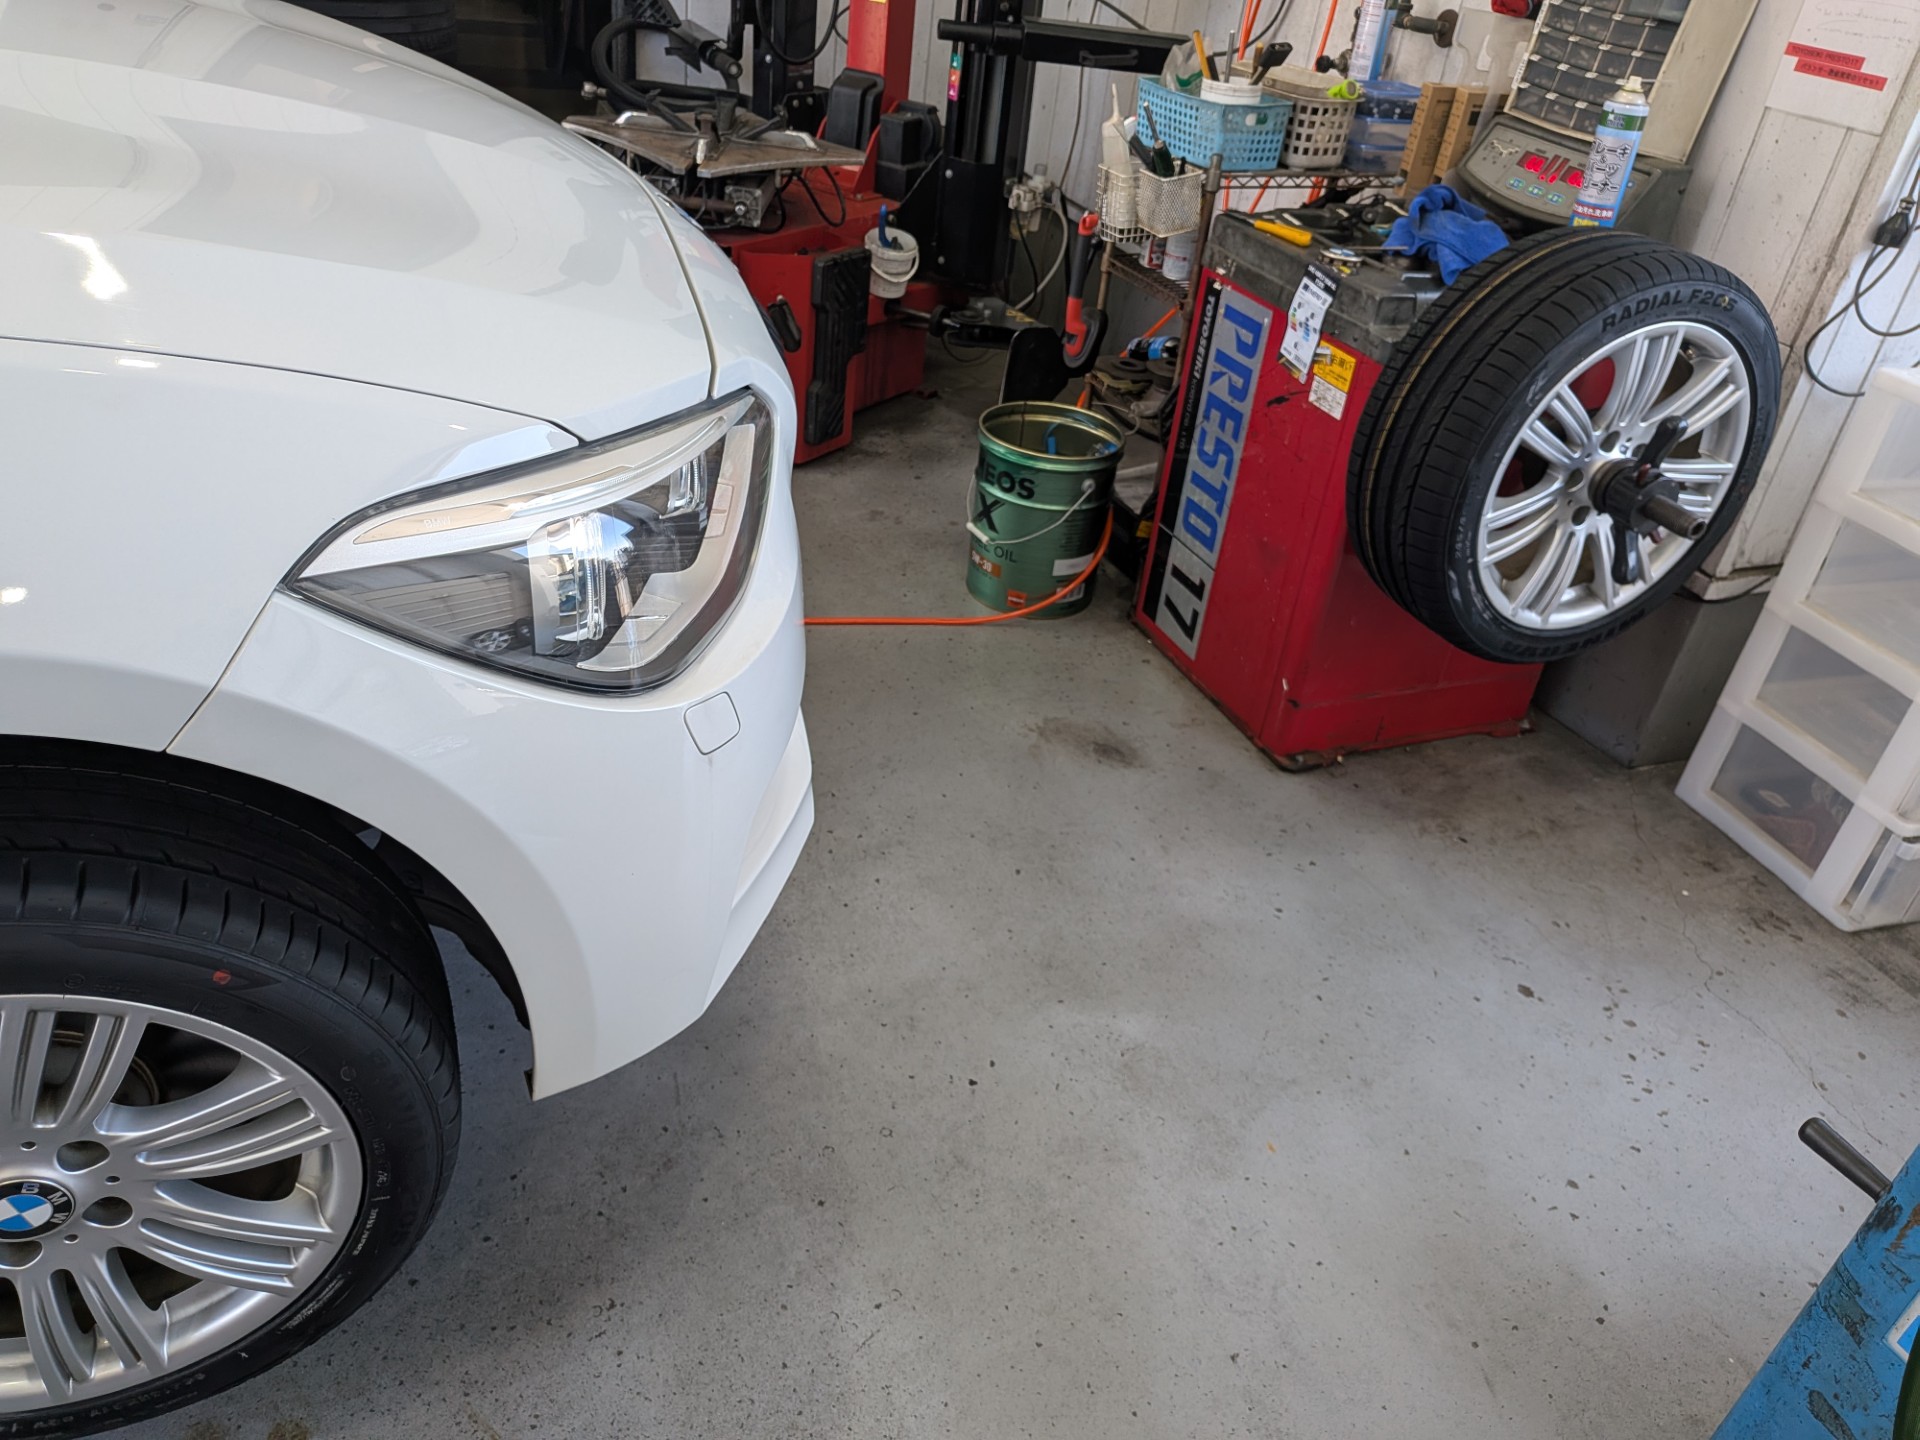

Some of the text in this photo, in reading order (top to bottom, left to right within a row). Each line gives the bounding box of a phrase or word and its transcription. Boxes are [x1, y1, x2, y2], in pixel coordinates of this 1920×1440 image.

[1601, 288, 1738, 333] RADIAL F205
[1193, 295, 1215, 380] TOYOSEIKI
[1183, 304, 1263, 554] PRESTO
[424, 516, 451, 529] BMW
[975, 492, 1006, 534] X
[994, 545, 1017, 564] OIL
[1164, 563, 1206, 642] 17
[20, 1182, 69, 1224] BMW
